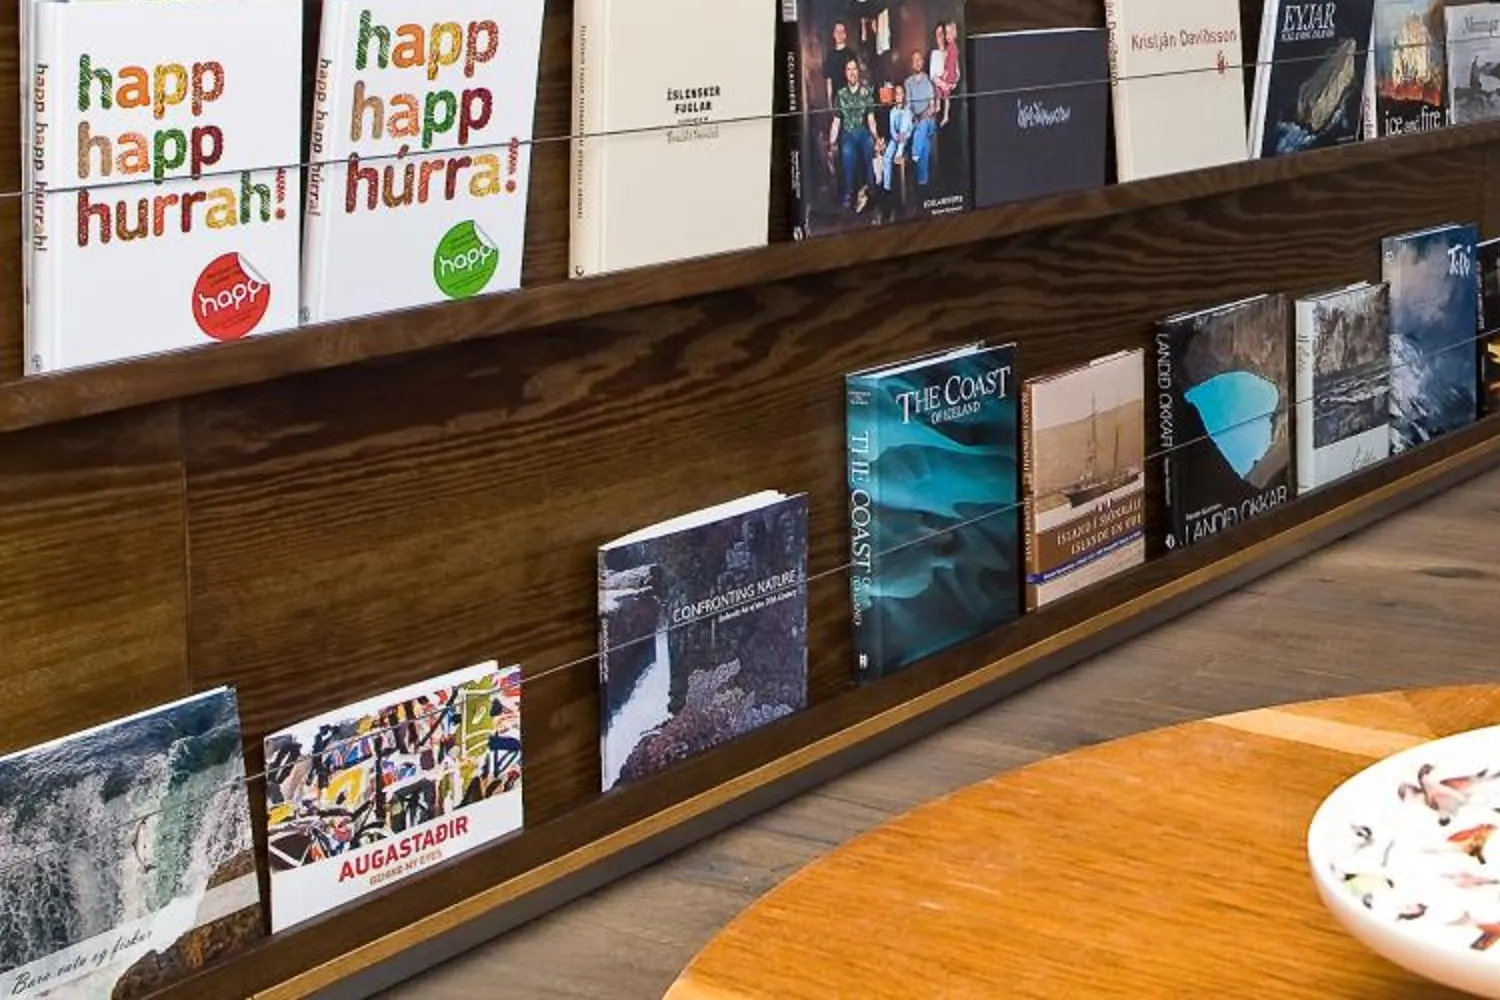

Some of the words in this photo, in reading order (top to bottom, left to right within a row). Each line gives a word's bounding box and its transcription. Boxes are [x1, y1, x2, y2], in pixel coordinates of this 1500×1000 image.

[355, 9, 499, 80] happ
[1283, 2, 1336, 31] EYJAR
[36, 64, 49, 110] happ
[77, 53, 225, 119] happ
[316, 58, 332, 103] happ
[675, 101, 712, 114] FUGLAR
[312, 111, 328, 153] happ
[351, 80, 493, 149] happ
[1385, 110, 1403, 137] ice
[1421, 105, 1441, 131] fire
[35, 120, 49, 171] happ
[76, 121, 224, 184] happ
[345, 137, 520, 213] húrra!
[77, 167, 288, 247] hurrah!
[896, 385, 941, 424] THE
[944, 365, 1011, 405] COAST
[852, 431, 869, 483] THE
[852, 488, 871, 573] COAST
[673, 584, 755, 623] CONFRONTING
[757, 569, 796, 594] NATURE
[338, 816, 469, 882] AUGASTAÐIR
